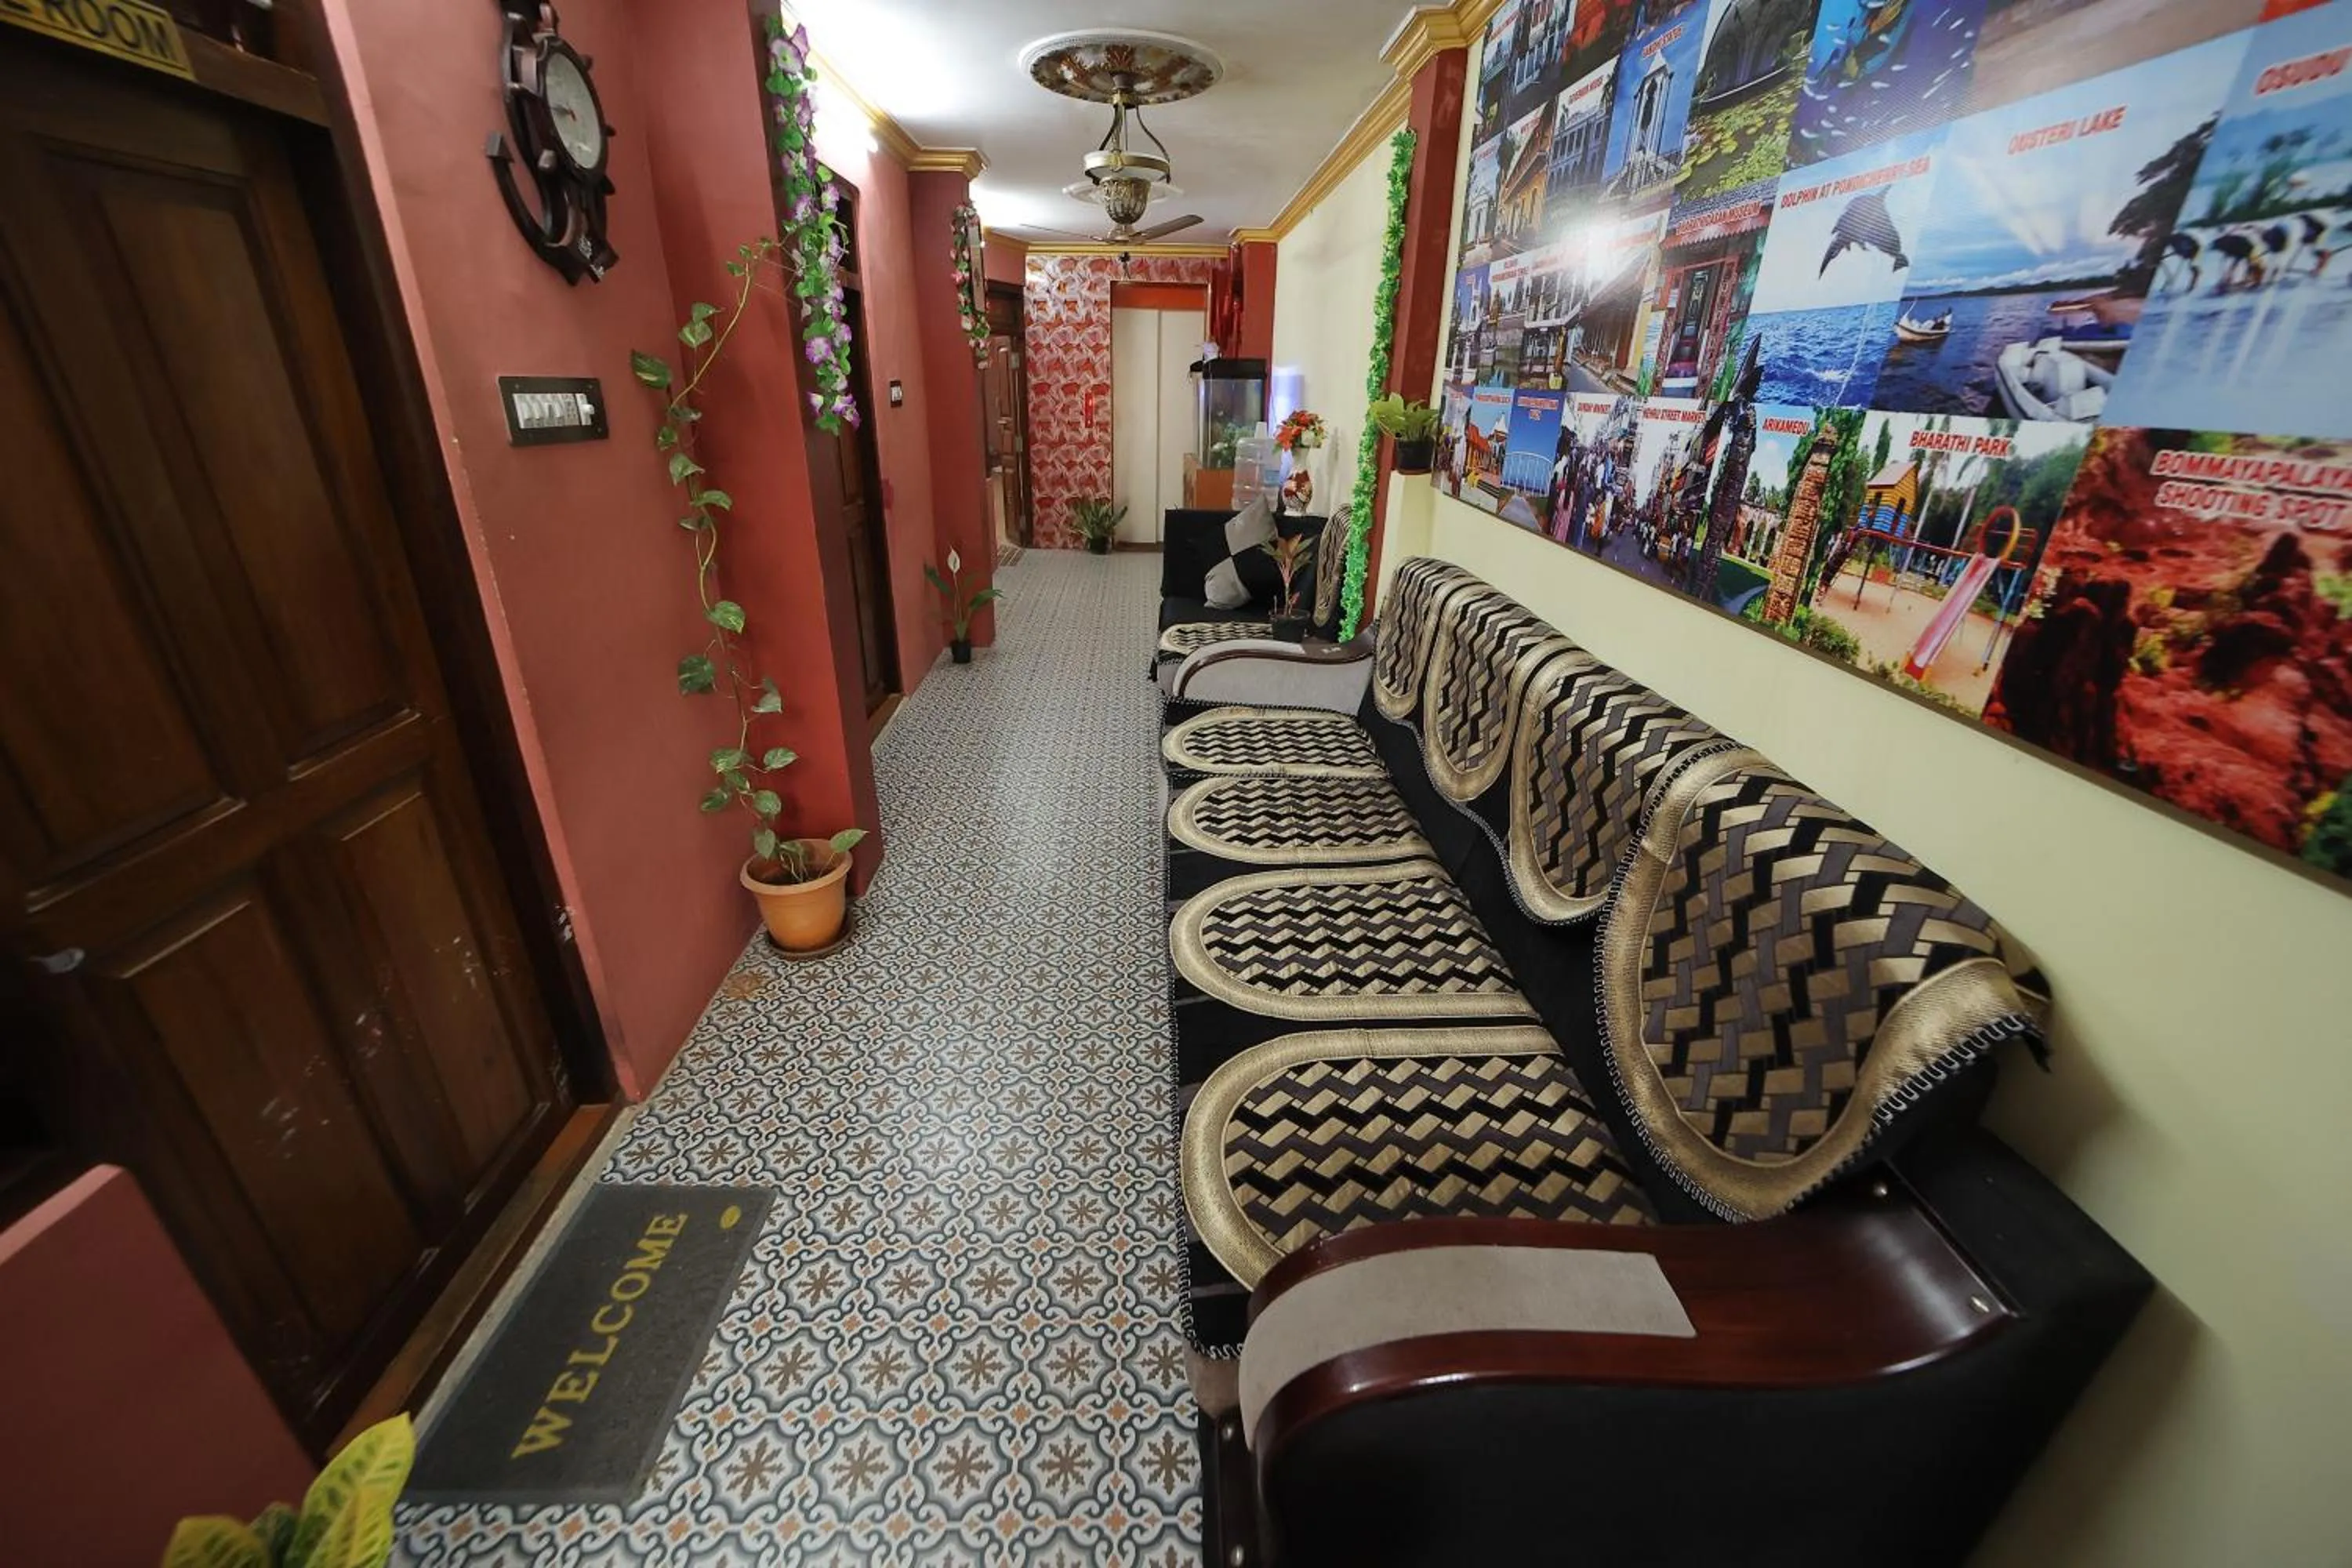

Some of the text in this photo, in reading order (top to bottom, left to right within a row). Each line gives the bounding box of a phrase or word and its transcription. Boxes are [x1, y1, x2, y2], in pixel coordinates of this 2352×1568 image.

[44, 0, 171, 60] ROOM
[2007, 105, 2127, 155] OUSTERI LAKE
[1781, 186, 1819, 209] DOLPHIN
[1818, 183, 1833, 200] AT
[1681, 410, 1707, 423] MARKET
[1762, 418, 1810, 435] ARIKAMEDU
[1909, 430, 2012, 456] BHARATHI PARK
[2158, 484, 2347, 528] SHOOTING SPOT
[511, 1213, 688, 1460] WELCOME
